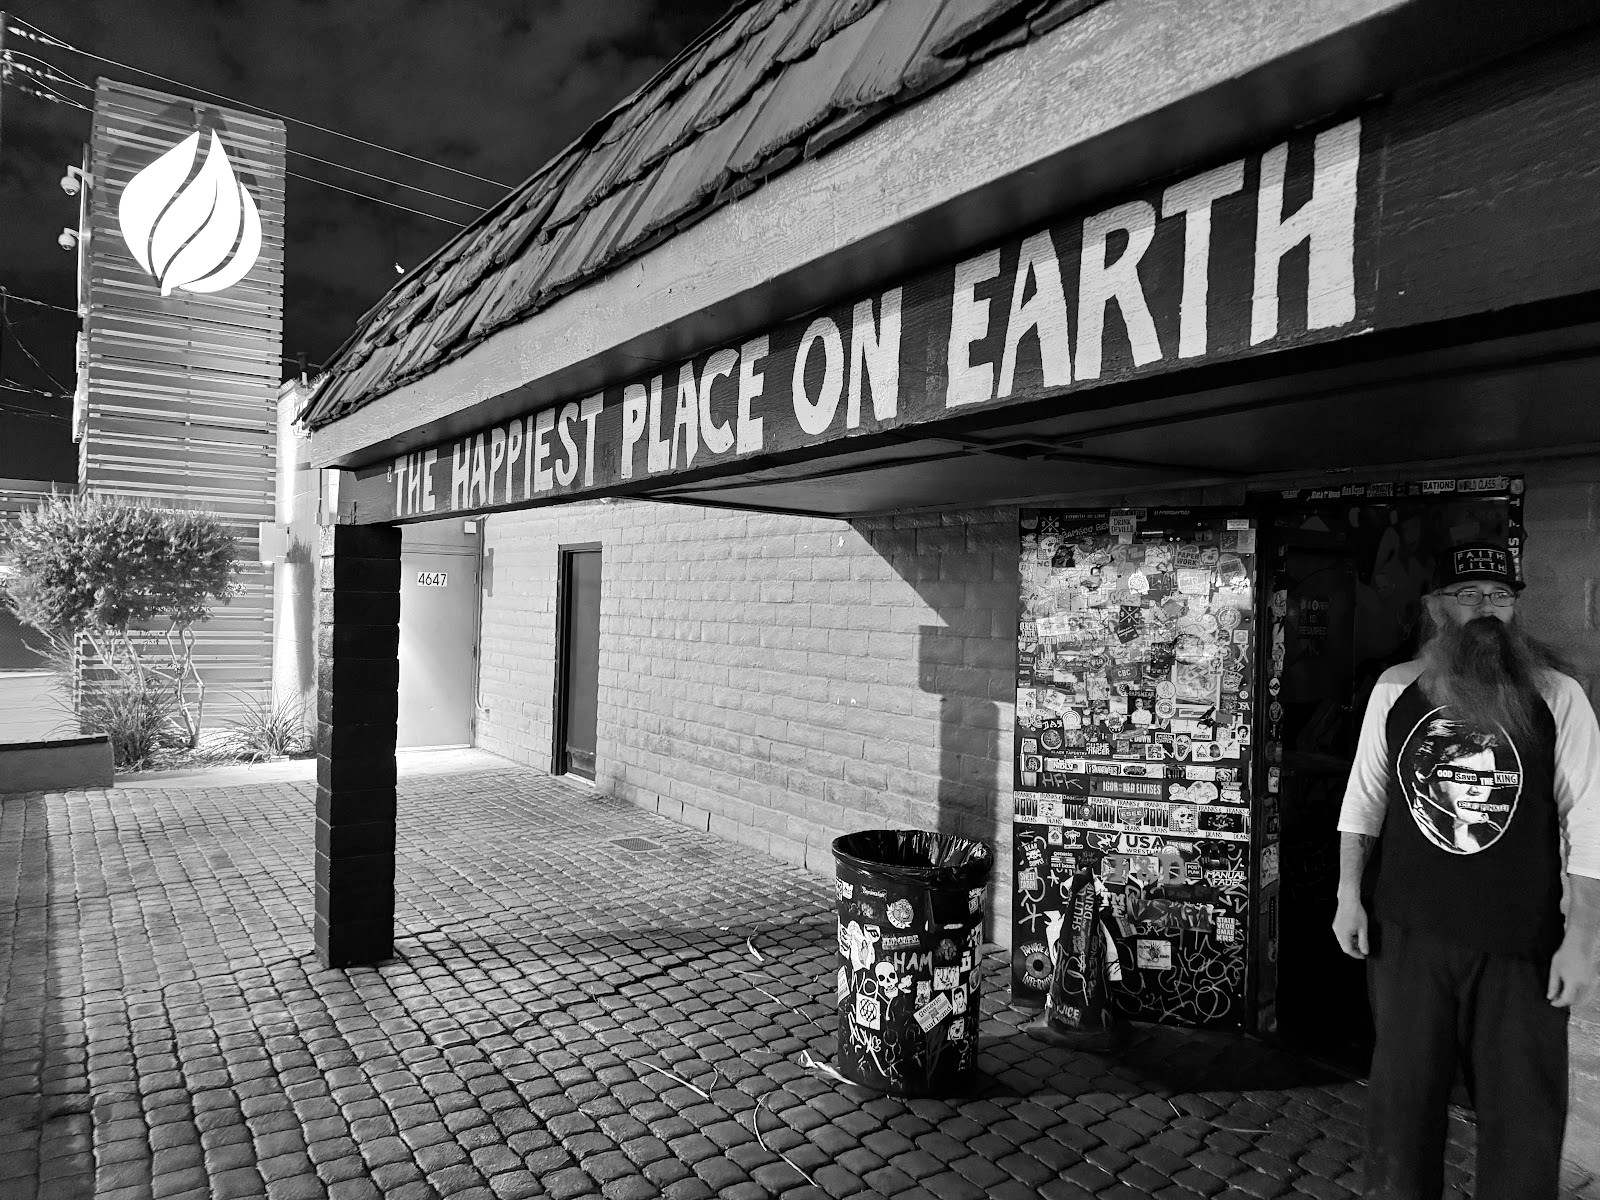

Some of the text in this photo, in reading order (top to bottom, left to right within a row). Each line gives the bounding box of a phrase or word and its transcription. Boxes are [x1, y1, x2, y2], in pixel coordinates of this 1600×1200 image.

[395, 117, 1362, 516] THE HAPPIEST PLACE ON EARTH
[1458, 550, 1503, 560] FAITH
[1459, 562, 1505, 572] FILTH
[418, 573, 447, 586] 4647
[1437, 770, 1453, 778] GOD
[1480, 777, 1494, 785] THE
[1496, 774, 1517, 784] KING
[1136, 783, 1161, 795] ELVISES
[1126, 835, 1162, 850] USA
[1206, 870, 1245, 879] MANUAL
[1072, 899, 1084, 931] SHUT
[894, 951, 933, 976] HAM
